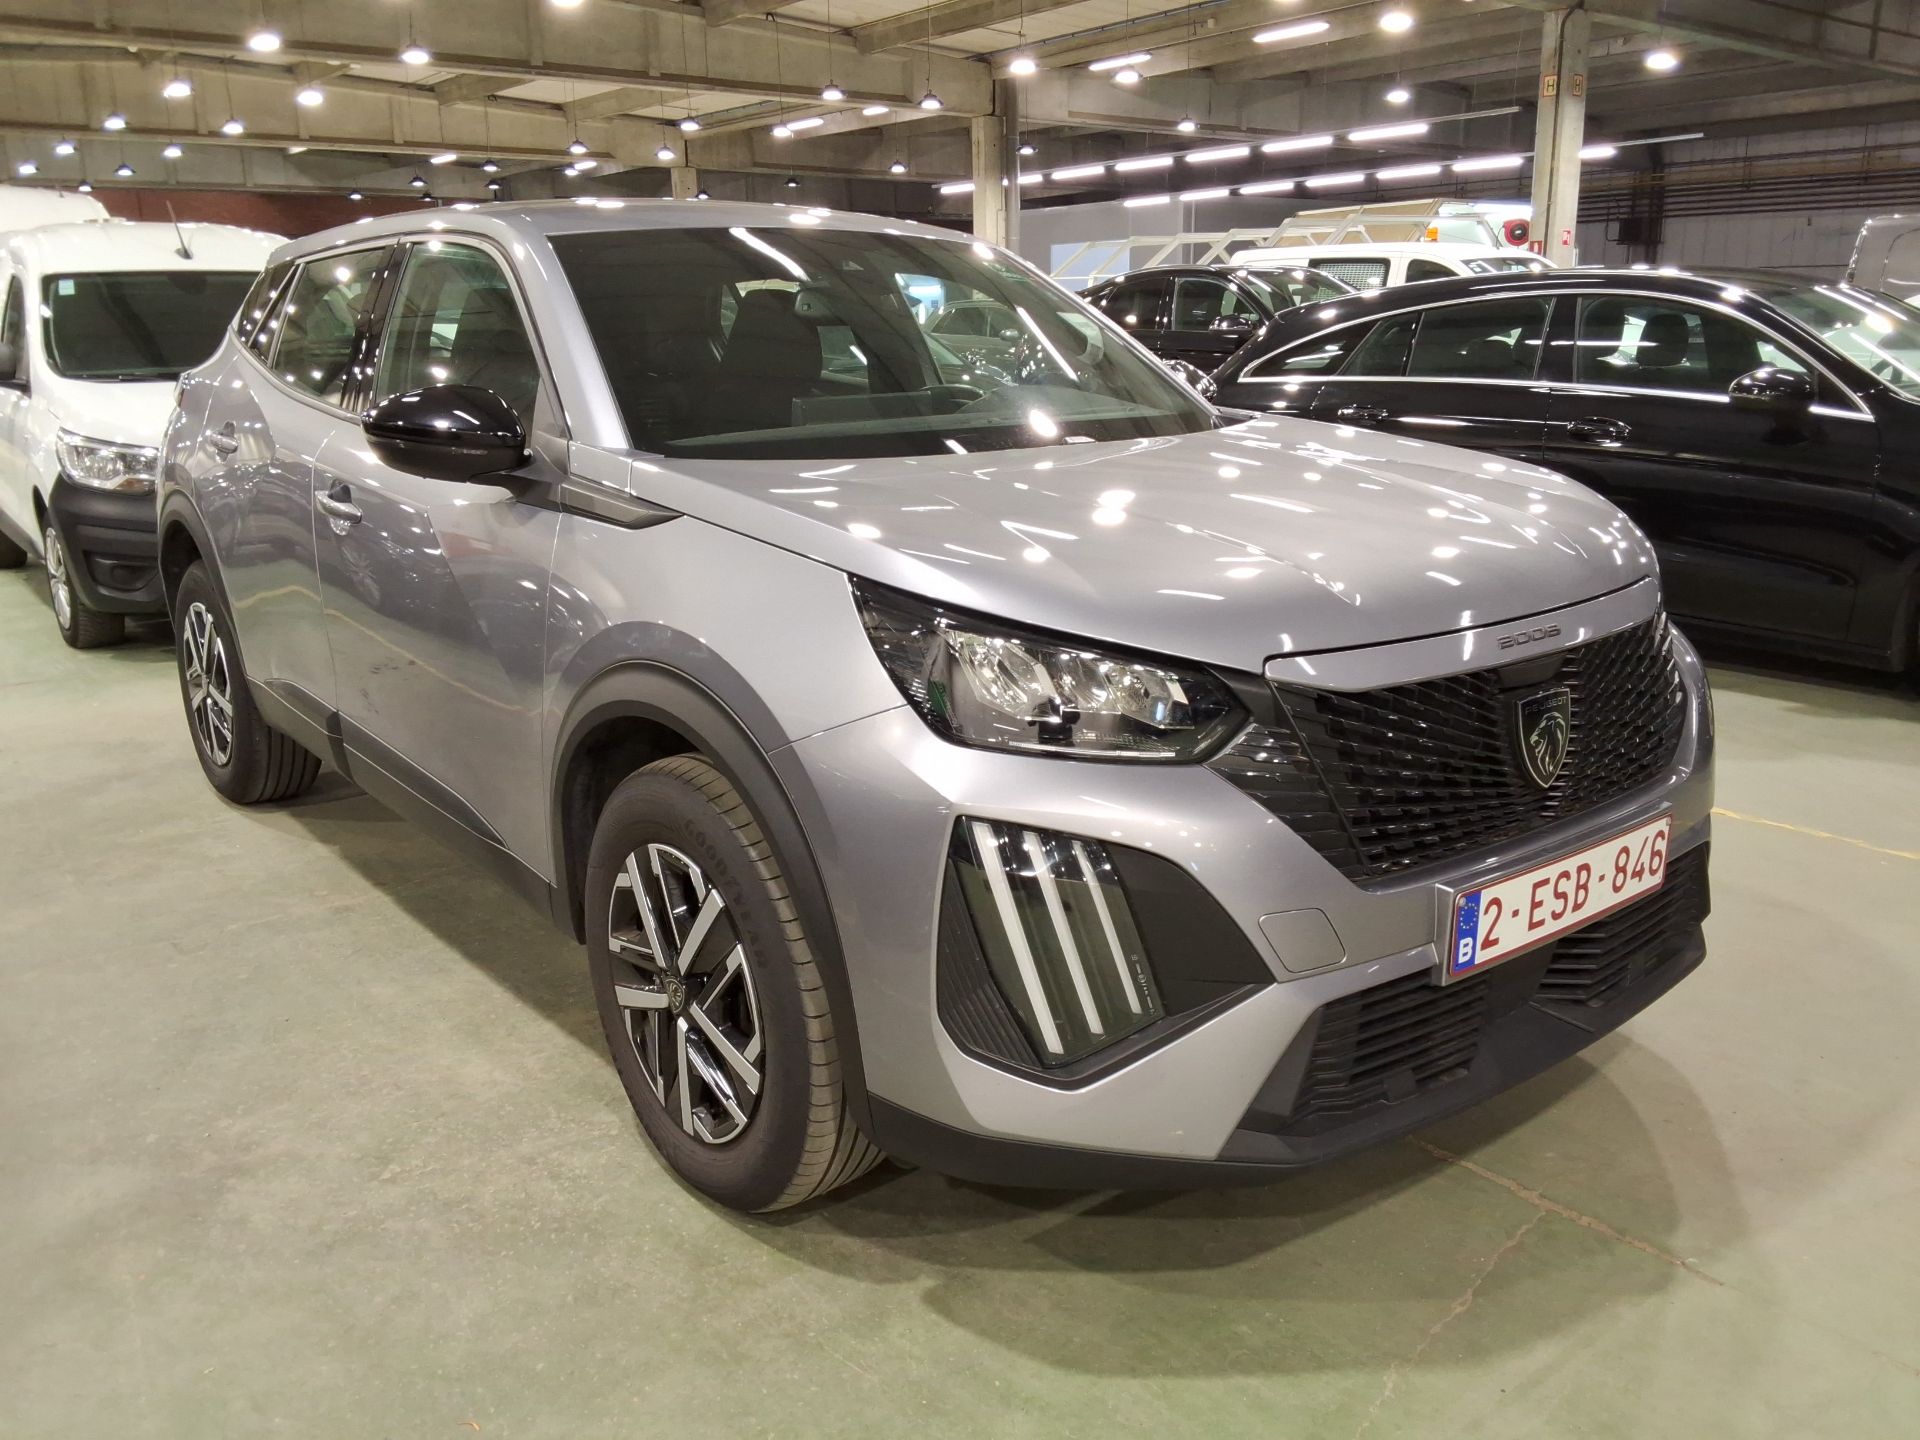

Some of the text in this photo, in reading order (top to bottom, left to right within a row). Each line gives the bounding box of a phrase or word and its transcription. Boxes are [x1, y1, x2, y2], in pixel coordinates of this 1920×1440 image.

[1546, 79, 1555, 93] H
[1497, 623, 1561, 649] 2008
[1525, 696, 1567, 714] PEUGEOT
[1458, 829, 1666, 963] B 2-ESB-846
